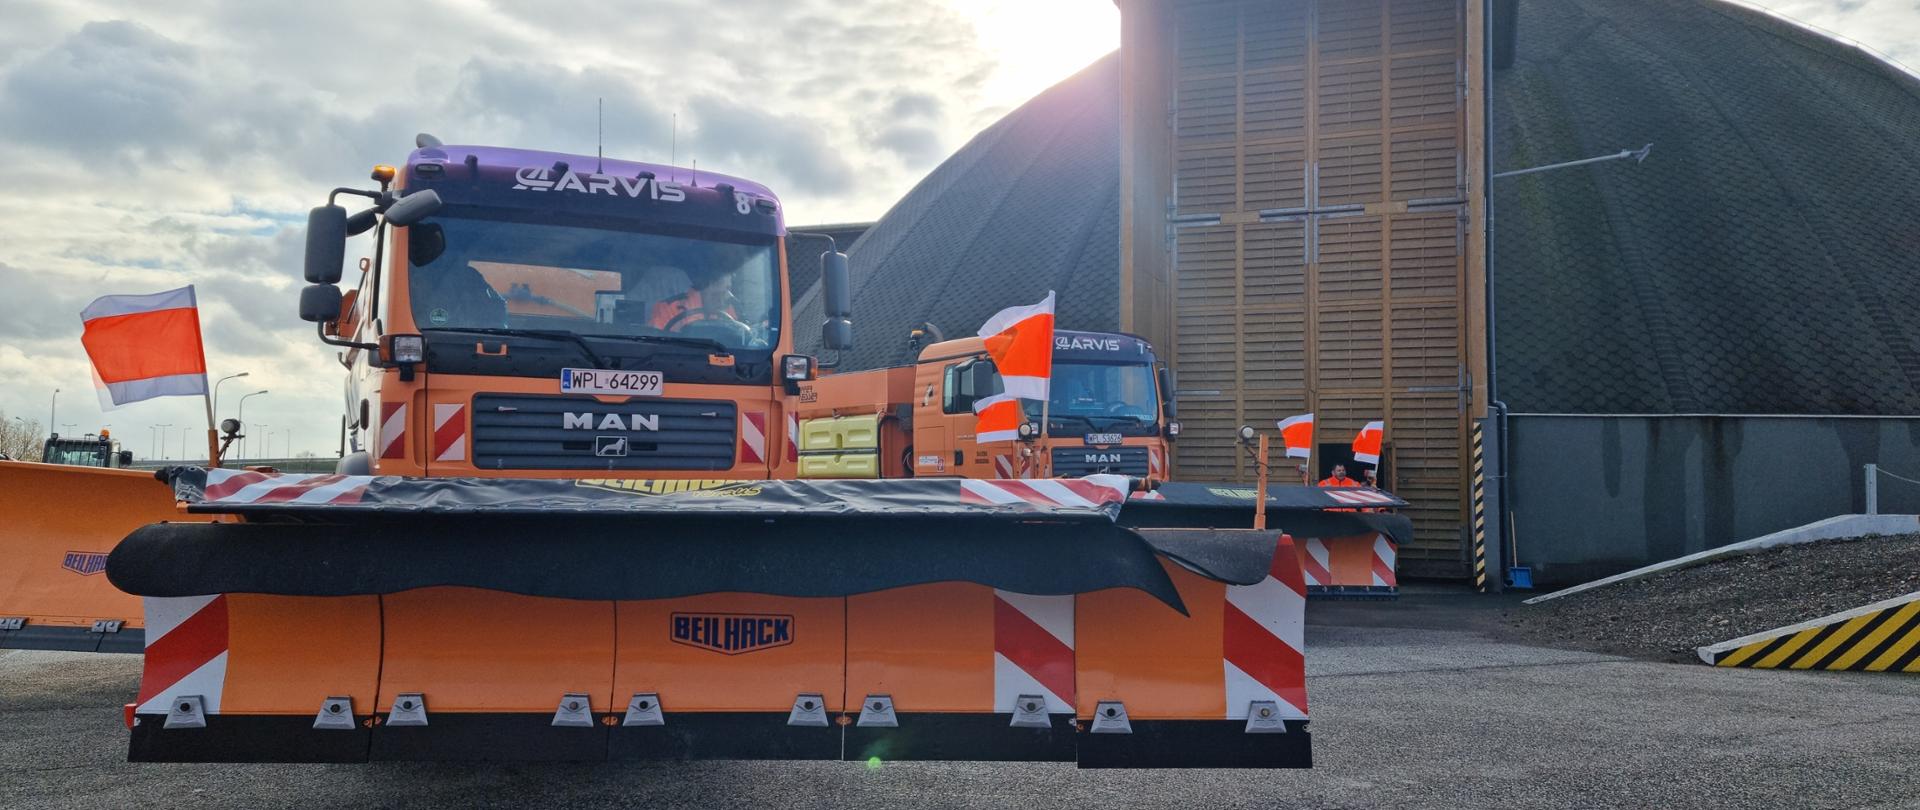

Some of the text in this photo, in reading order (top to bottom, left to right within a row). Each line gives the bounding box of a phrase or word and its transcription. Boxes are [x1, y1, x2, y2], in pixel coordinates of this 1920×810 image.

[734, 191, 752, 215] 8
[1137, 342, 1145, 355] 7
[572, 372, 604, 390] WPL
[609, 373, 659, 391] 64299
[563, 411, 659, 432] MAN
[1085, 453, 1121, 463] MAN
[674, 616, 791, 652] BEILHACK
